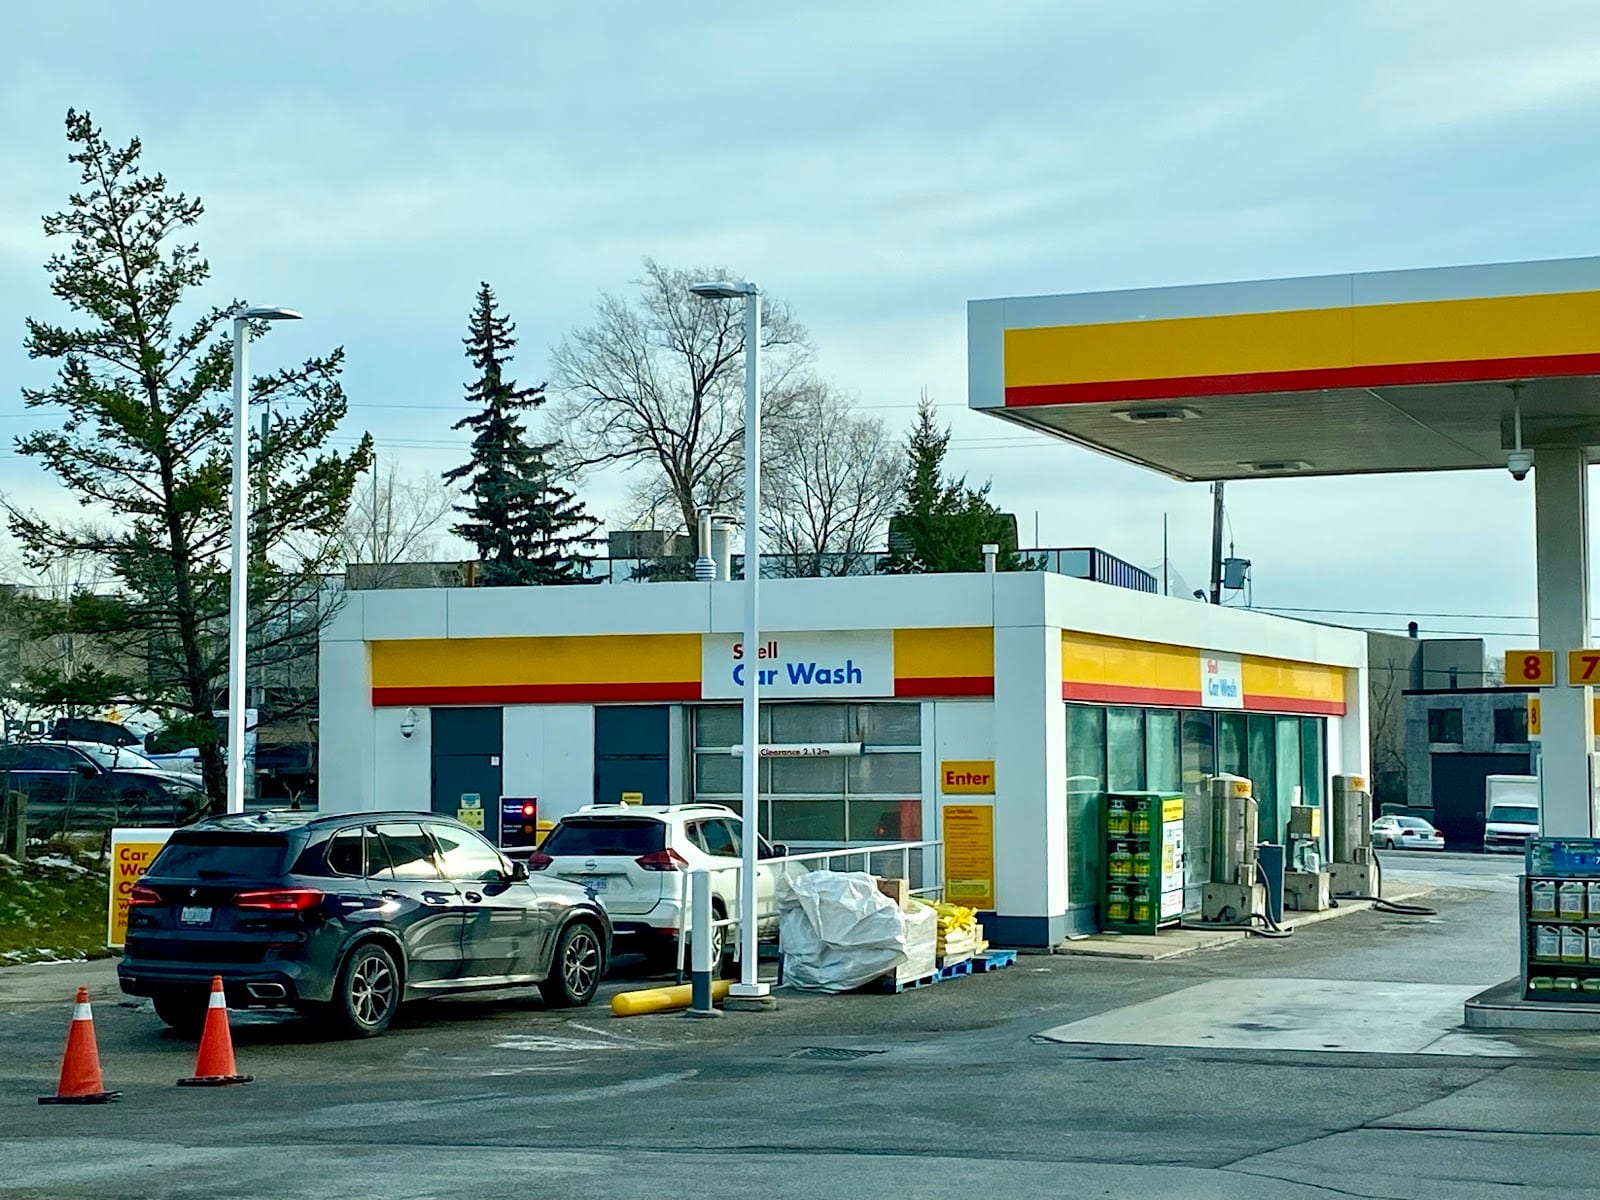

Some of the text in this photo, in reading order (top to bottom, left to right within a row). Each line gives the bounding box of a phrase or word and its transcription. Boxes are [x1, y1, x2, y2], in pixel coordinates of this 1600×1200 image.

[733, 641, 778, 660] Sell
[786, 660, 862, 685] Wash
[1523, 655, 1541, 680] 8
[1581, 656, 1600, 680] 7
[1530, 706, 1537, 725] 8
[760, 747, 830, 756] Clearance 2.13m
[945, 770, 990, 786] Enter
[120, 847, 149, 861] Car
[120, 863, 146, 876] Wa
